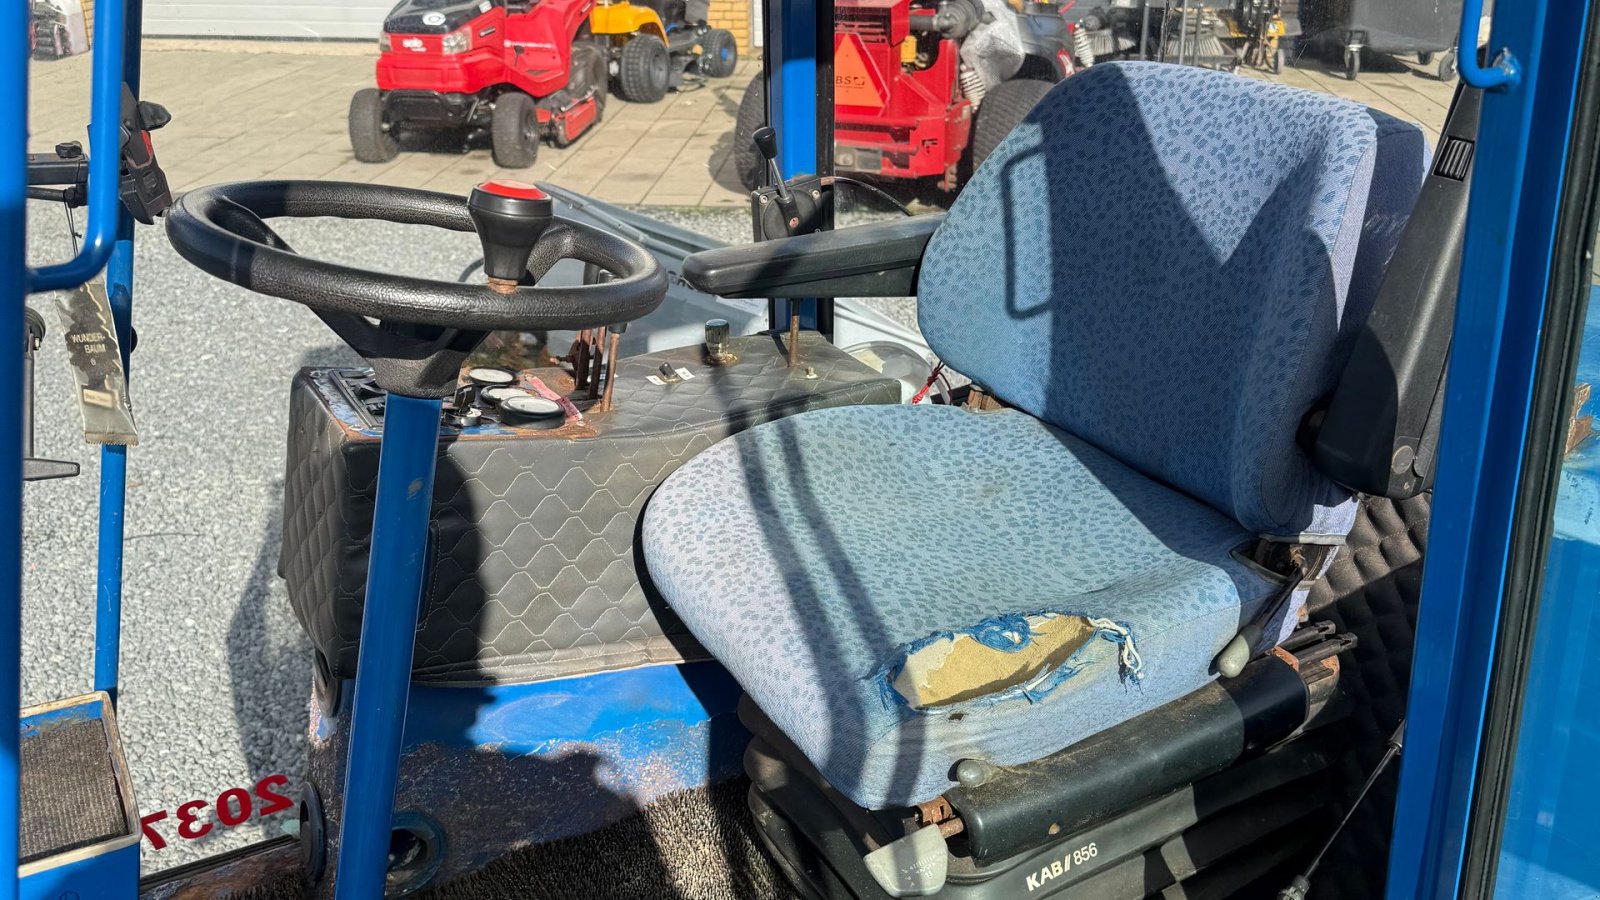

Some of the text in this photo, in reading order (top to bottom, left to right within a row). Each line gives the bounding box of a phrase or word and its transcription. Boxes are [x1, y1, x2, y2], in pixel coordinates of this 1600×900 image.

[70, 332, 106, 344] WUNDER-
[84, 343, 106, 354] BAUM
[1073, 842, 1098, 865] 856
